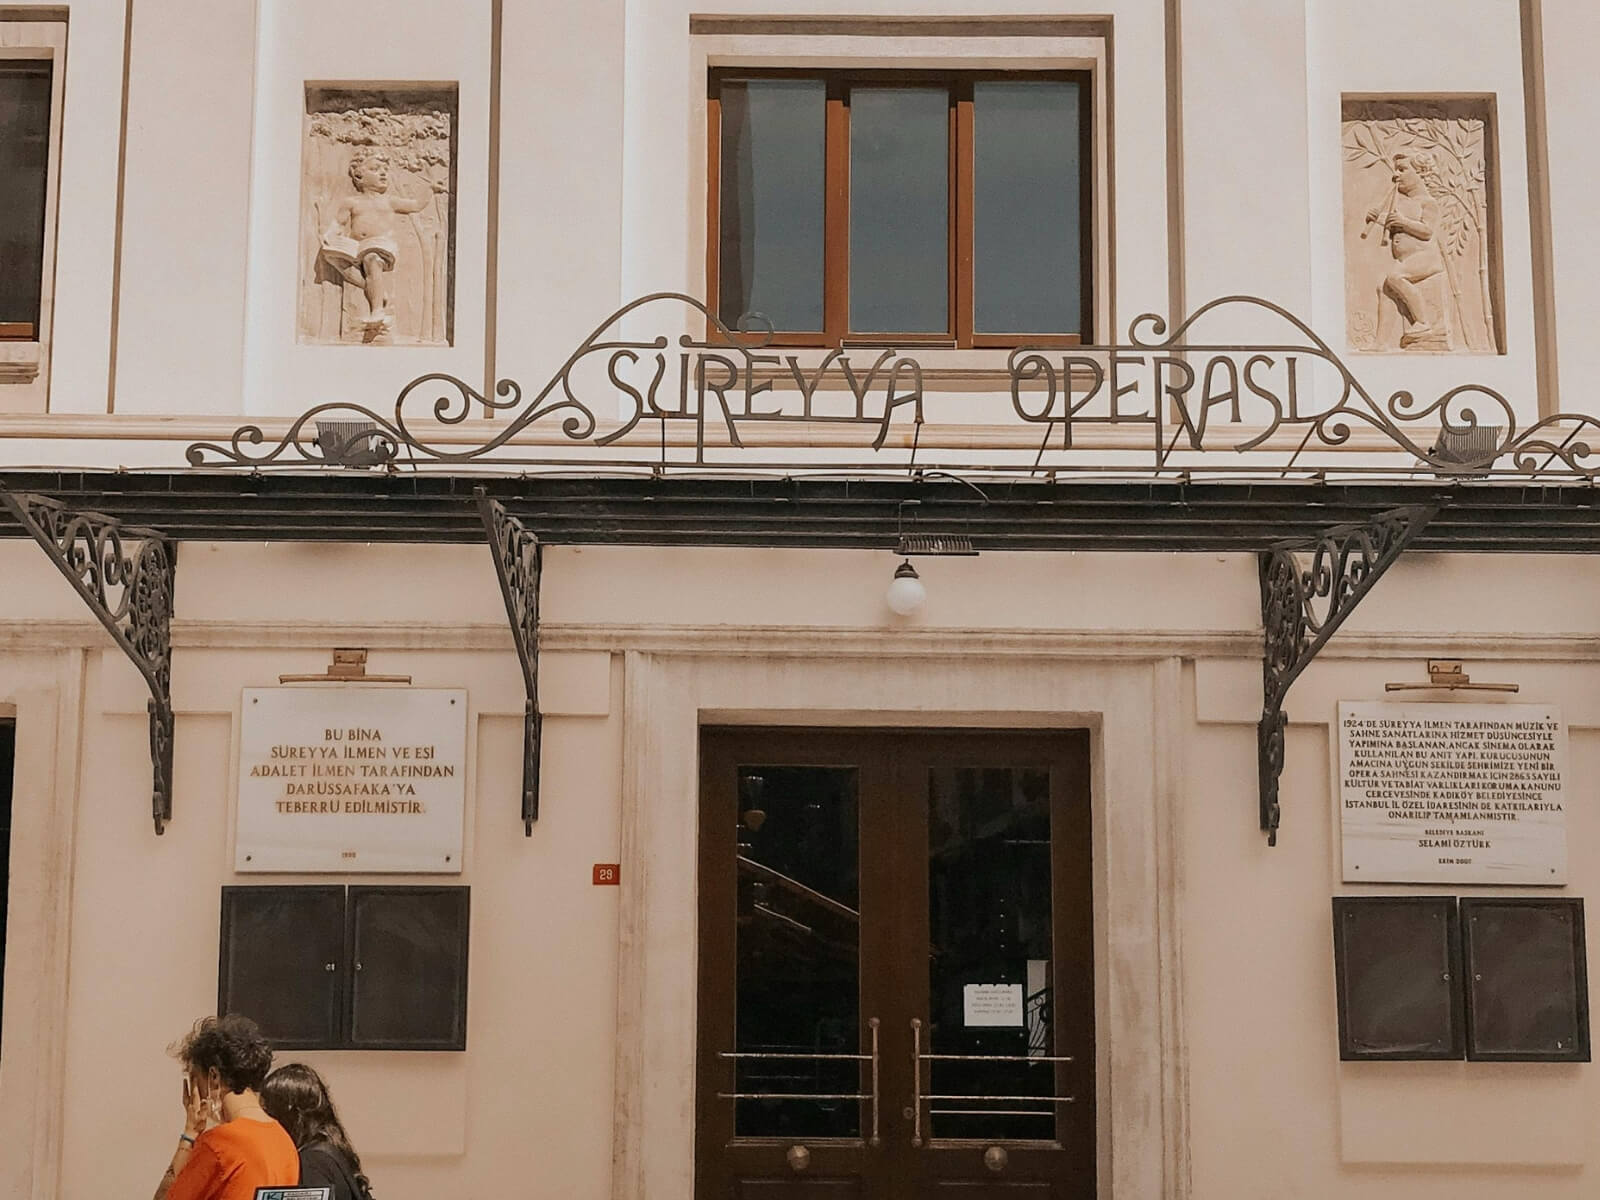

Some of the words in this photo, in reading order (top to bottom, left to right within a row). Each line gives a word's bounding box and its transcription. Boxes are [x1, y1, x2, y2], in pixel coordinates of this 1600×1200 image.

[1008, 353, 1298, 467] OPERASI
[325, 729, 343, 740] BU
[349, 729, 381, 741] BİNA
[1349, 740, 1393, 748] YAPIMINA
[344, 747, 385, 758] İLMEN
[392, 747, 410, 759] VE
[1355, 750, 1413, 758] KULLANILAN
[1416, 751, 1427, 759] BU
[250, 765, 307, 776] ADALET
[313, 765, 354, 776] İLMEN
[360, 766, 454, 777] TARAFINDAN
[1421, 771, 1488, 779] KAZANDIRMAK
[1382, 780, 1394, 788] VE
[600, 868, 613, 880] 29
